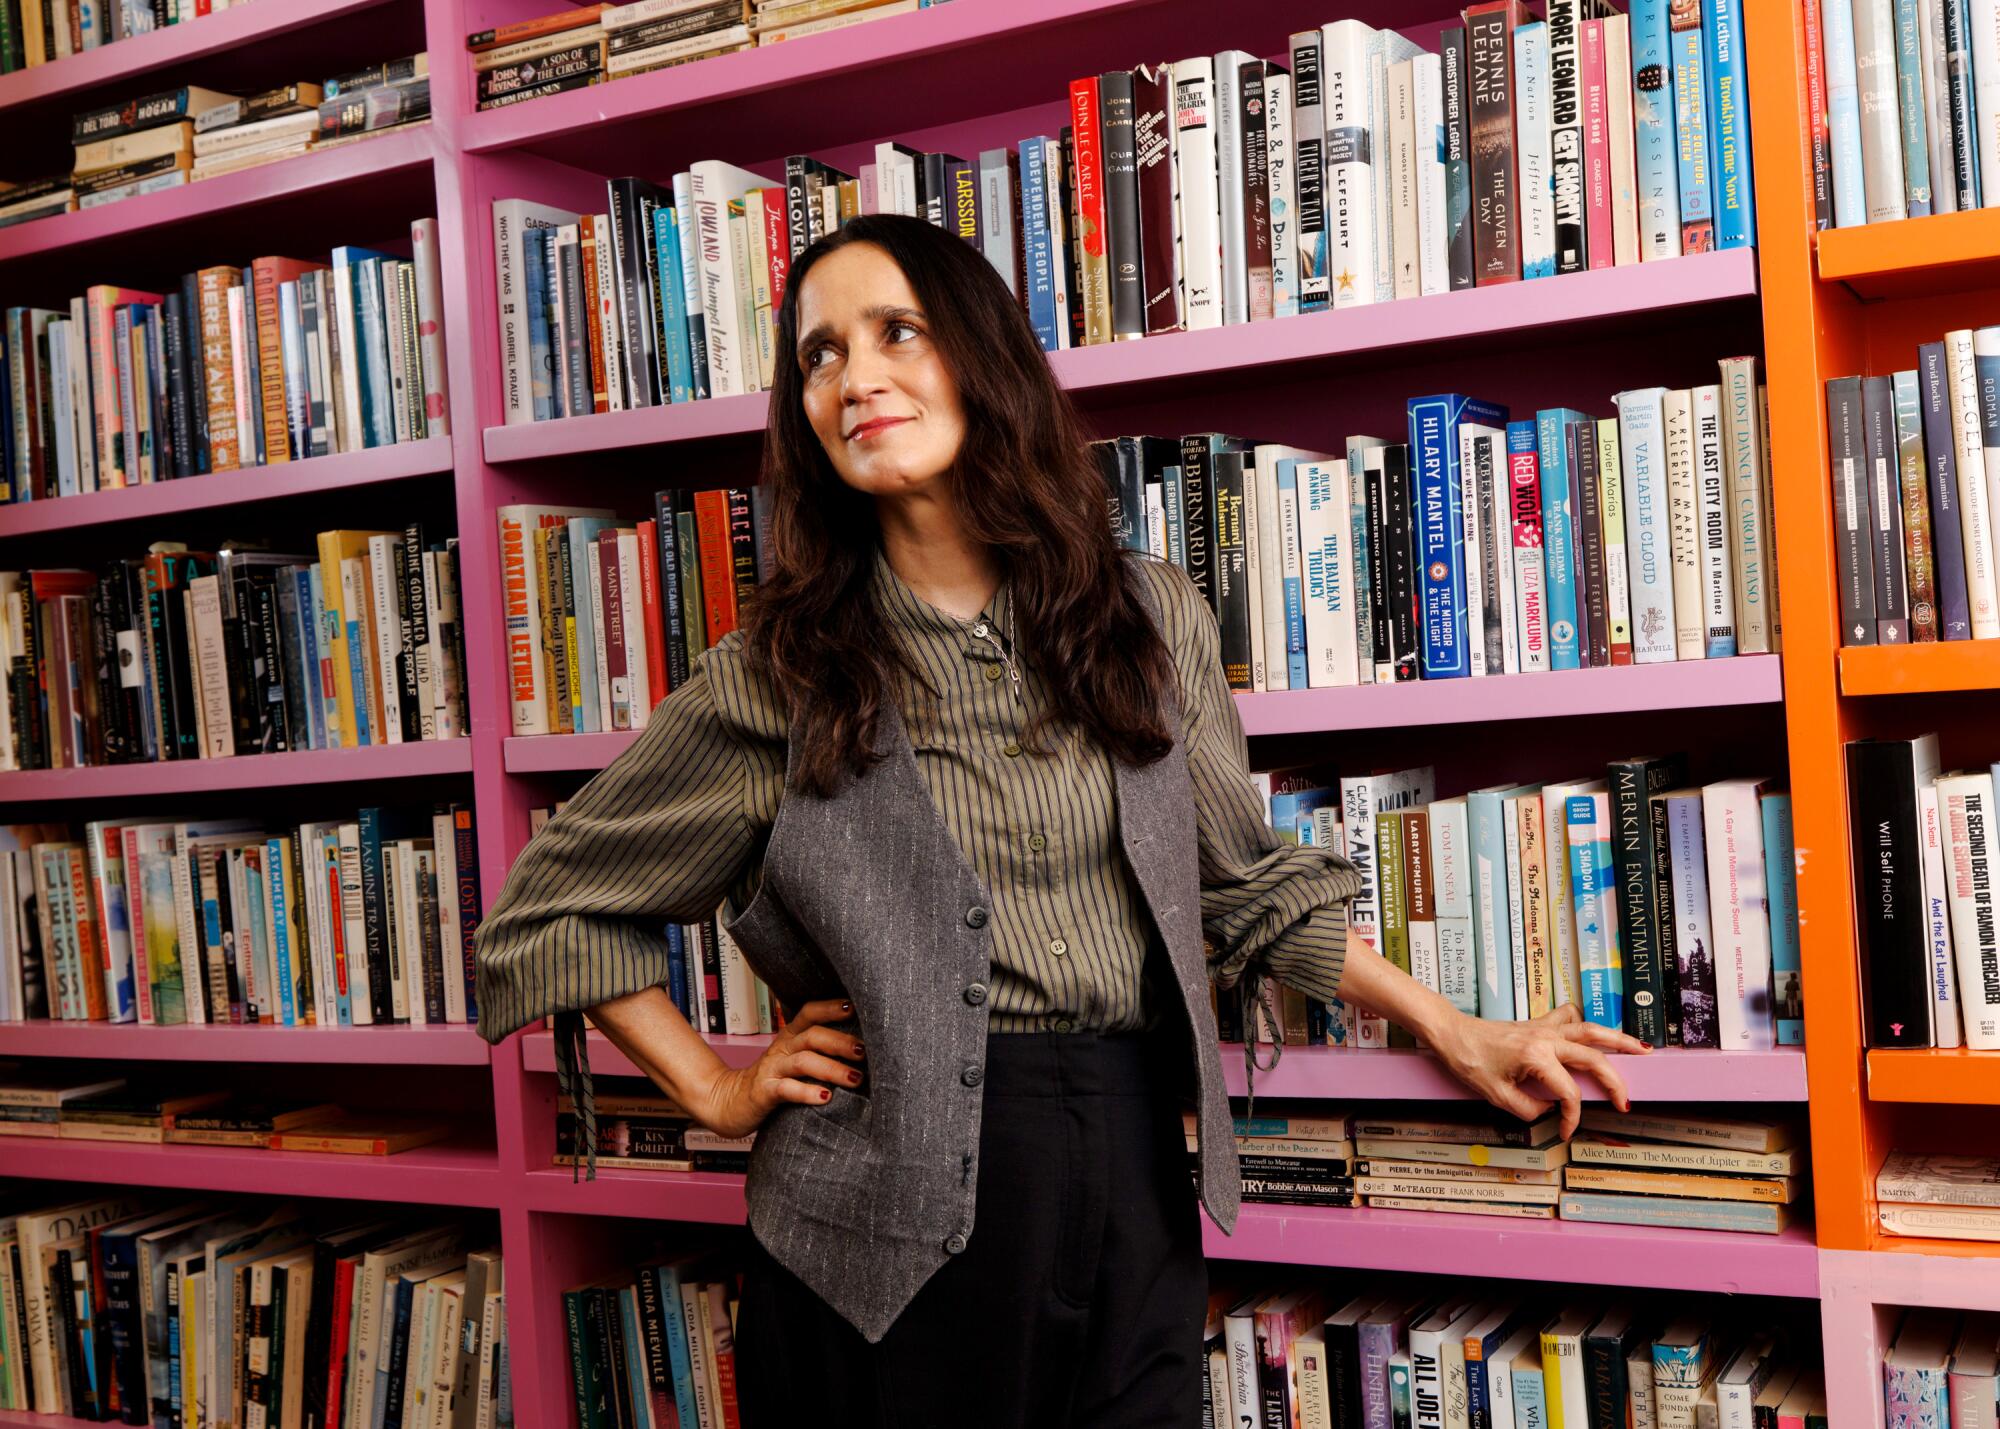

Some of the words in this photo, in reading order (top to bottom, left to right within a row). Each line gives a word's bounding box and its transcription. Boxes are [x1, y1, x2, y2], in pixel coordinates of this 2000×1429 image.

[1525, 40, 1535, 69] Lost
[1717, 15, 1730, 62] Lethem
[537, 71, 553, 81] THE
[556, 61, 588, 76] CIRCUS
[550, 53, 568, 65] SON
[571, 49, 583, 59] OF
[1296, 49, 1317, 72] GUS
[1473, 24, 1488, 105] LEHANE
[1489, 22, 1504, 102] DENNIS
[1298, 80, 1318, 105] LEE
[1334, 72, 1343, 121] PETER
[1446, 47, 1458, 119] CHRISTOPHER
[1526, 76, 1536, 121] Nation
[138, 100, 177, 121] HOGAN
[1075, 90, 1090, 127] JOHN
[1269, 88, 1281, 130] Wrack
[1720, 76, 1734, 134] Brooklyn
[1079, 132, 1090, 147] LE
[1270, 140, 1282, 151] &
[1723, 137, 1736, 173] Crime
[1272, 159, 1284, 191] Ruin
[1299, 144, 1321, 193] TIGER'S
[1494, 169, 1505, 197] THE
[1528, 154, 1539, 200] Jeffrey
[956, 170, 975, 237] LARSSON
[1028, 146, 1044, 236] INDEPENDENT
[1338, 169, 1348, 248] LEFCOURT
[1725, 176, 1739, 209] Novel
[499, 216, 508, 240] WHO
[1301, 199, 1323, 231] TAIL
[1480, 197, 1491, 225] DAY
[1495, 205, 1506, 248] GIVEN
[1533, 208, 1542, 236] Lent
[695, 201, 719, 262] LOWLAND
[766, 204, 780, 250] Jhumpa
[773, 256, 784, 292] Lahiri
[1272, 222, 1288, 251] Don
[501, 243, 510, 270] THEY
[1035, 243, 1048, 293] PEOPLE
[1274, 258, 1286, 283] Lee
[503, 273, 511, 295] WAS
[204, 275, 219, 336] HERE
[505, 322, 516, 365] GABRIEL
[1929, 354, 1940, 379] David
[210, 368, 224, 403] AM
[509, 368, 518, 409] KRAUZE
[1930, 380, 1941, 412] Rocklin
[1984, 378, 1997, 428] RODMAN
[1701, 415, 1716, 438] THE
[1896, 381, 1919, 447] LILA
[1423, 417, 1441, 479] HILARY
[1603, 440, 1615, 473] Javier
[1703, 443, 1719, 474] LAST
[1937, 455, 1947, 471] The
[1166, 481, 1177, 521] BERNARD
[1308, 468, 1321, 510] MANNING
[1320, 474, 1331, 502] OLIVIA
[1635, 443, 1652, 525] VARIABLE
[1705, 478, 1720, 505] CITY
[1907, 456, 1920, 525] MARILYNNE
[1940, 472, 1950, 510] Luminist
[662, 507, 671, 526] LET
[1217, 488, 1229, 547] Malamud
[1230, 495, 1243, 545] Bernard
[1427, 487, 1445, 554] MANTEL
[1707, 512, 1722, 549] ROOM
[406, 528, 419, 574] NADINE
[663, 528, 673, 549] THE
[1323, 535, 1337, 559] THE
[503, 519, 528, 616] JONATHAN
[666, 551, 675, 571] OLD
[1221, 554, 1230, 597] tenants
[1233, 553, 1243, 572] the
[1308, 550, 1324, 599] TRILOGY
[1641, 531, 1656, 585] CLOUD
[1913, 530, 1925, 589] ROBINSON
[607, 566, 617, 598] MAIN
[667, 573, 677, 616] DREAMS
[1325, 563, 1341, 612] BALKAN
[1524, 567, 1539, 589] LIZA
[1713, 571, 1723, 615] Martinez
[410, 578, 425, 641] GORDIMER
[1430, 596, 1440, 616] THE
[1440, 587, 1450, 606] THE
[610, 601, 621, 647] STREET
[670, 619, 679, 636] DIE
[1431, 619, 1441, 647] LIGHT
[1442, 609, 1453, 647] MIRROR
[1525, 592, 1542, 651] MARKLUND
[415, 651, 428, 683] JUMP
[511, 634, 534, 702] LETHEM
[1619, 772, 1640, 851] MERKIN
[1965, 794, 1981, 812] THE
[1380, 821, 1390, 859] TERRY
[1410, 820, 1419, 853] LARRY
[1724, 818, 1735, 835] Gay
[1879, 821, 1892, 846] Will
[1967, 815, 1986, 856] SECOND
[1728, 837, 1736, 853] and
[1880, 852, 1893, 874] Self
[361, 840, 378, 903] JASMINE
[1528, 865, 1539, 886] The
[1728, 856, 1740, 905] Melancholy
[1971, 858, 1989, 891] DEATH
[1383, 864, 1395, 929] McMILLAN
[1529, 888, 1540, 933] Madonna
[1882, 879, 1893, 920] PHONE
[1932, 898, 1943, 918] And
[1975, 893, 1989, 904] OF
[366, 907, 379, 955] TRADE
[1626, 863, 1650, 983] ENCHANTMENT
[1732, 908, 1741, 935] Sound
[1934, 921, 1944, 937] the
[1975, 906, 1995, 945] RAMON
[1532, 937, 1541, 947] of
[1735, 947, 1743, 971] MERLE
[1934, 940, 1945, 958] Rat
[1533, 948, 1543, 996] Excelsior
[1936, 961, 1948, 1001] Laughed
[1981, 948, 2000, 1005] MERCADER
[1581, 1148, 1610, 1157] Alice
[1613, 1151, 1638, 1160] Munro
[1642, 1152, 1660, 1162] The
[1661, 1154, 1694, 1164] Moons
[1696, 1157, 1705, 1165] of
[1708, 1157, 1740, 1169] Jupiter
[1268, 1182, 1293, 1191] Bobbie
[1294, 1183, 1311, 1191] Ann
[1313, 1184, 1338, 1193] Mason
[1450, 1187, 1474, 1196] FRANK
[1476, 1188, 1505, 1197] NORRIS
[641, 1271, 654, 1313] CHINA
[1414, 1354, 1436, 1383] ALL
[1416, 1388, 1439, 1421] JOE
[1660, 1404, 1693, 1412] SUNDAY
